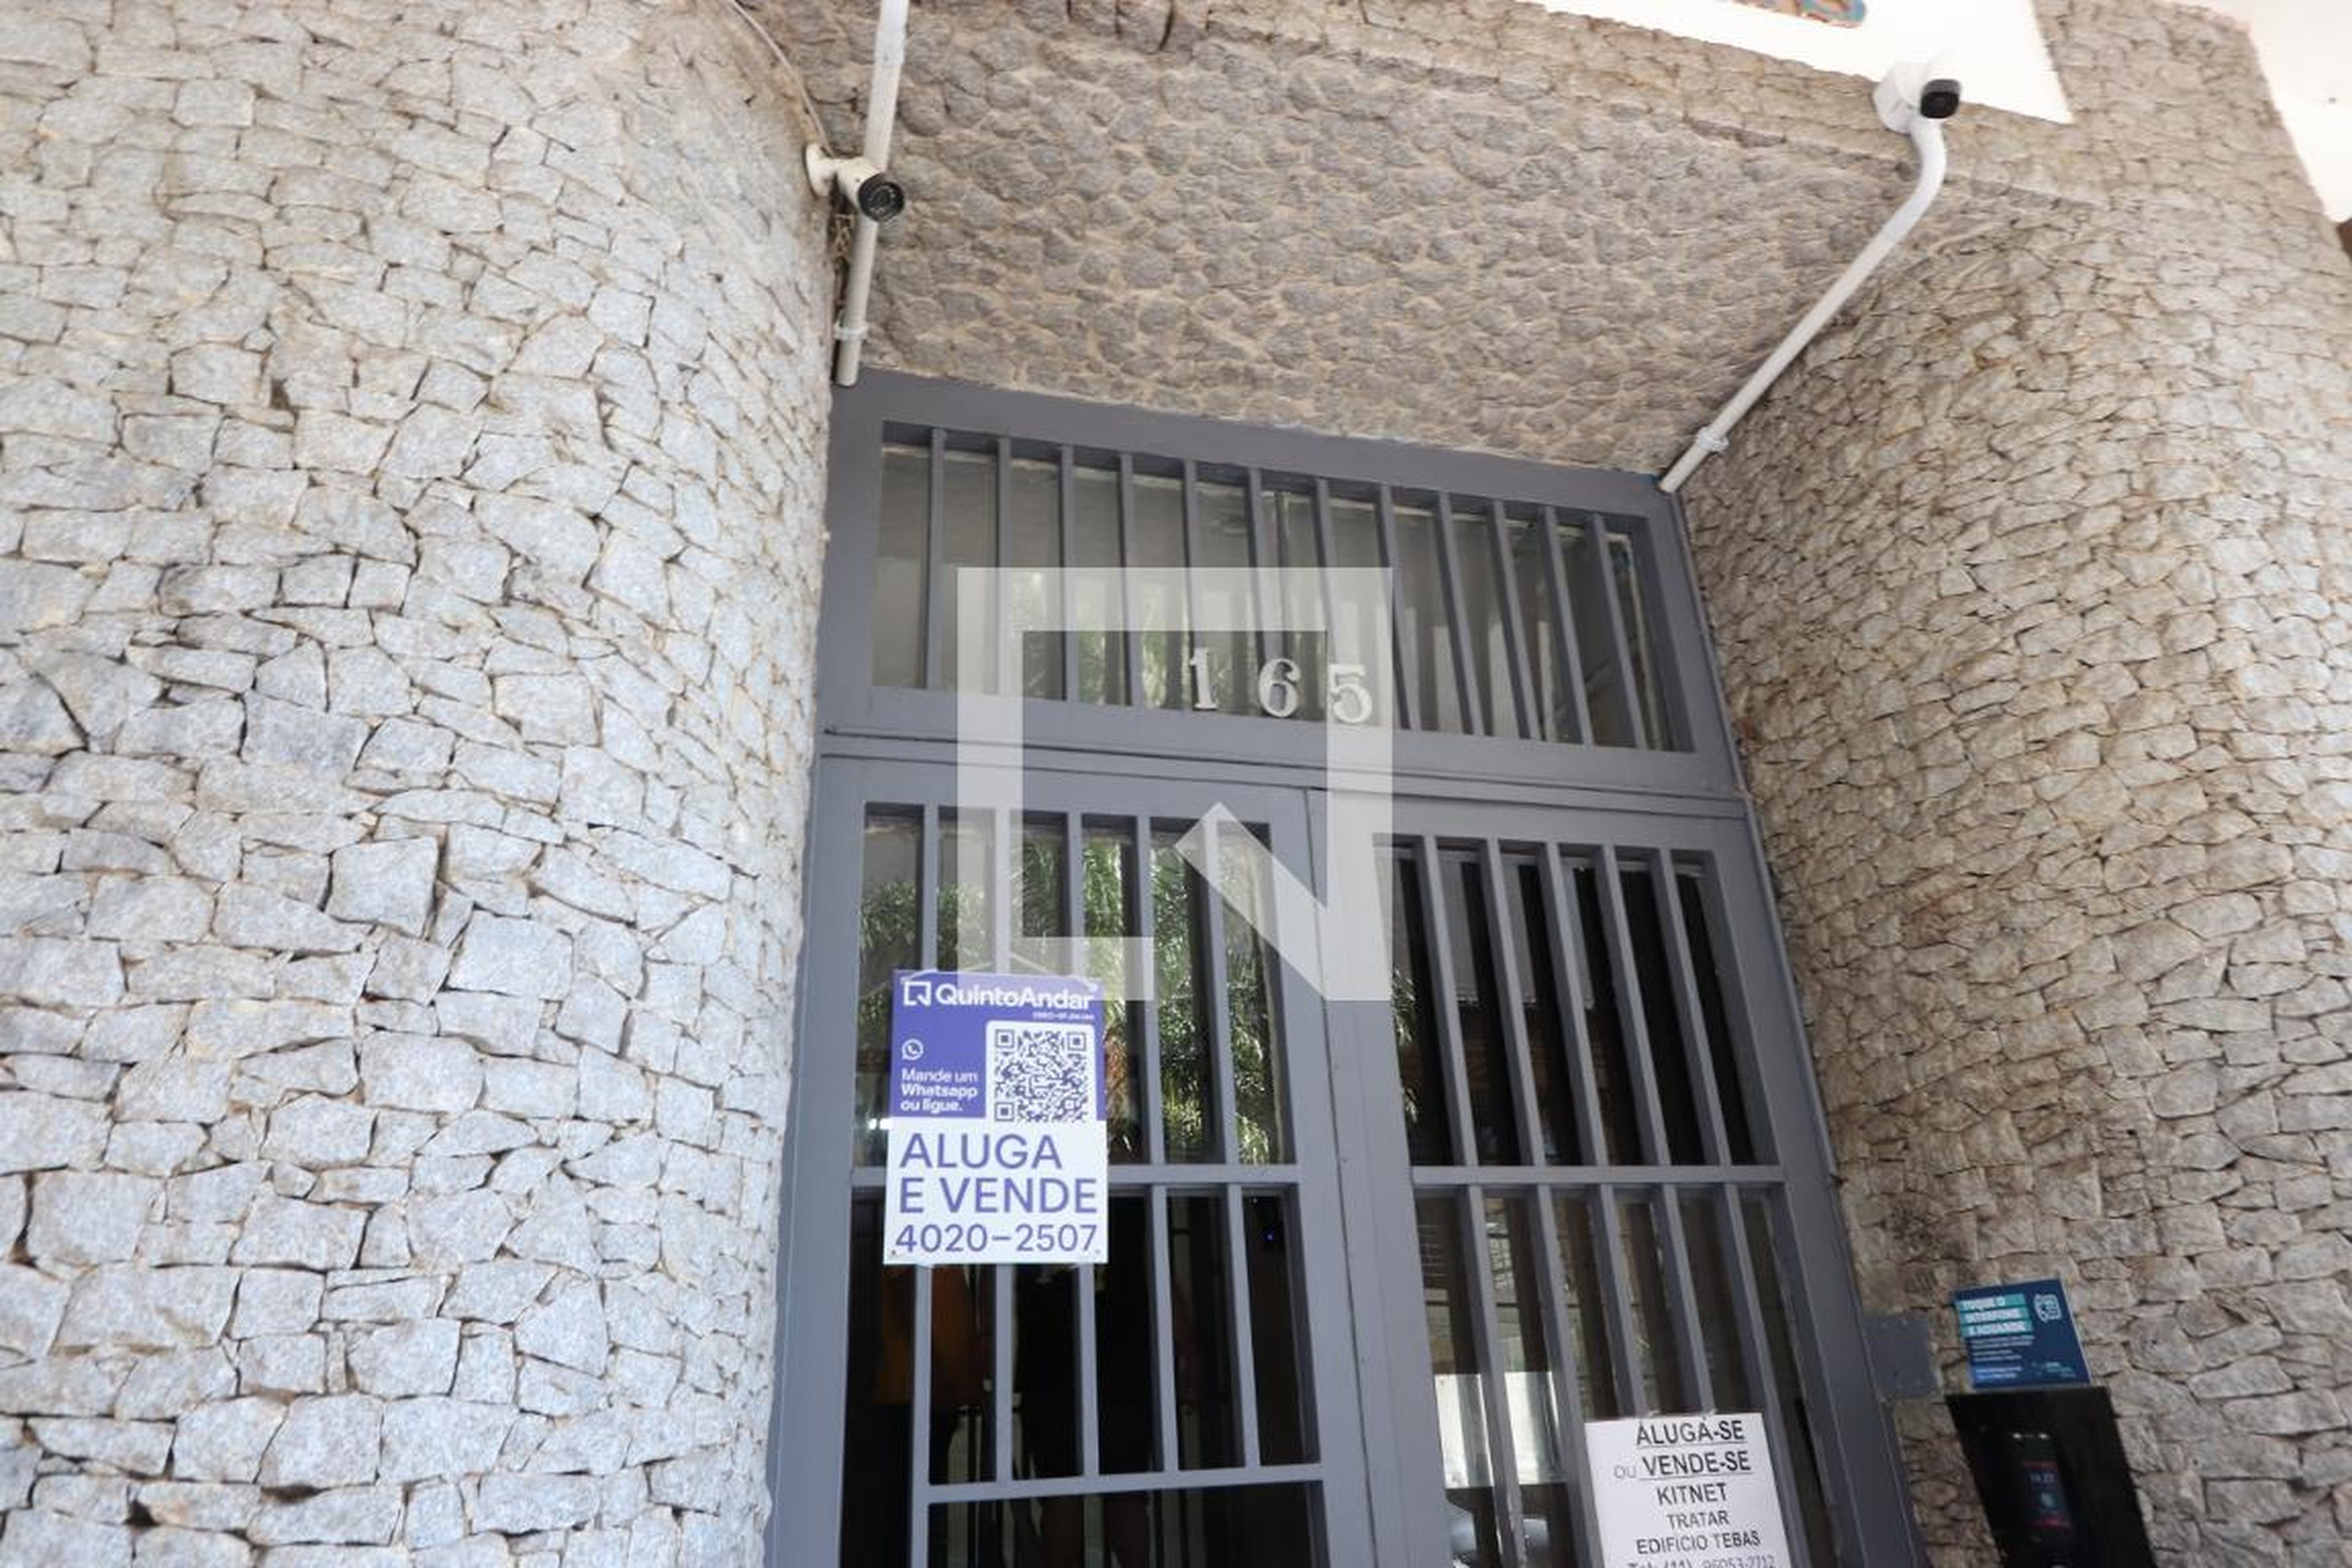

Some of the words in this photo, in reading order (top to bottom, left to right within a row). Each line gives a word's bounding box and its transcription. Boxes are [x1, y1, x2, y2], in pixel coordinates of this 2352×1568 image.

[1189, 647, 1373, 724] 165
[935, 984, 1095, 1010] QuintoAndar
[902, 1068, 952, 1082] Mande
[955, 1072, 978, 1083] um
[901, 1083, 978, 1101] Whatsapp
[900, 1101, 920, 1111] ou
[922, 1098, 963, 1114] ligue.
[899, 1133, 1062, 1169] ALUGA
[899, 1177, 924, 1213] E
[940, 1178, 1097, 1213] VENDE
[895, 1224, 1097, 1253] 4020-2507
[1636, 1420, 1744, 1446] ALUGA-SE
[1642, 1451, 1751, 1476] VENDE-SE
[1657, 1483, 1727, 1505] KITNET
[1666, 1510, 1730, 1530] TRATAR
[1713, 1530, 1761, 1548] TEBAS
